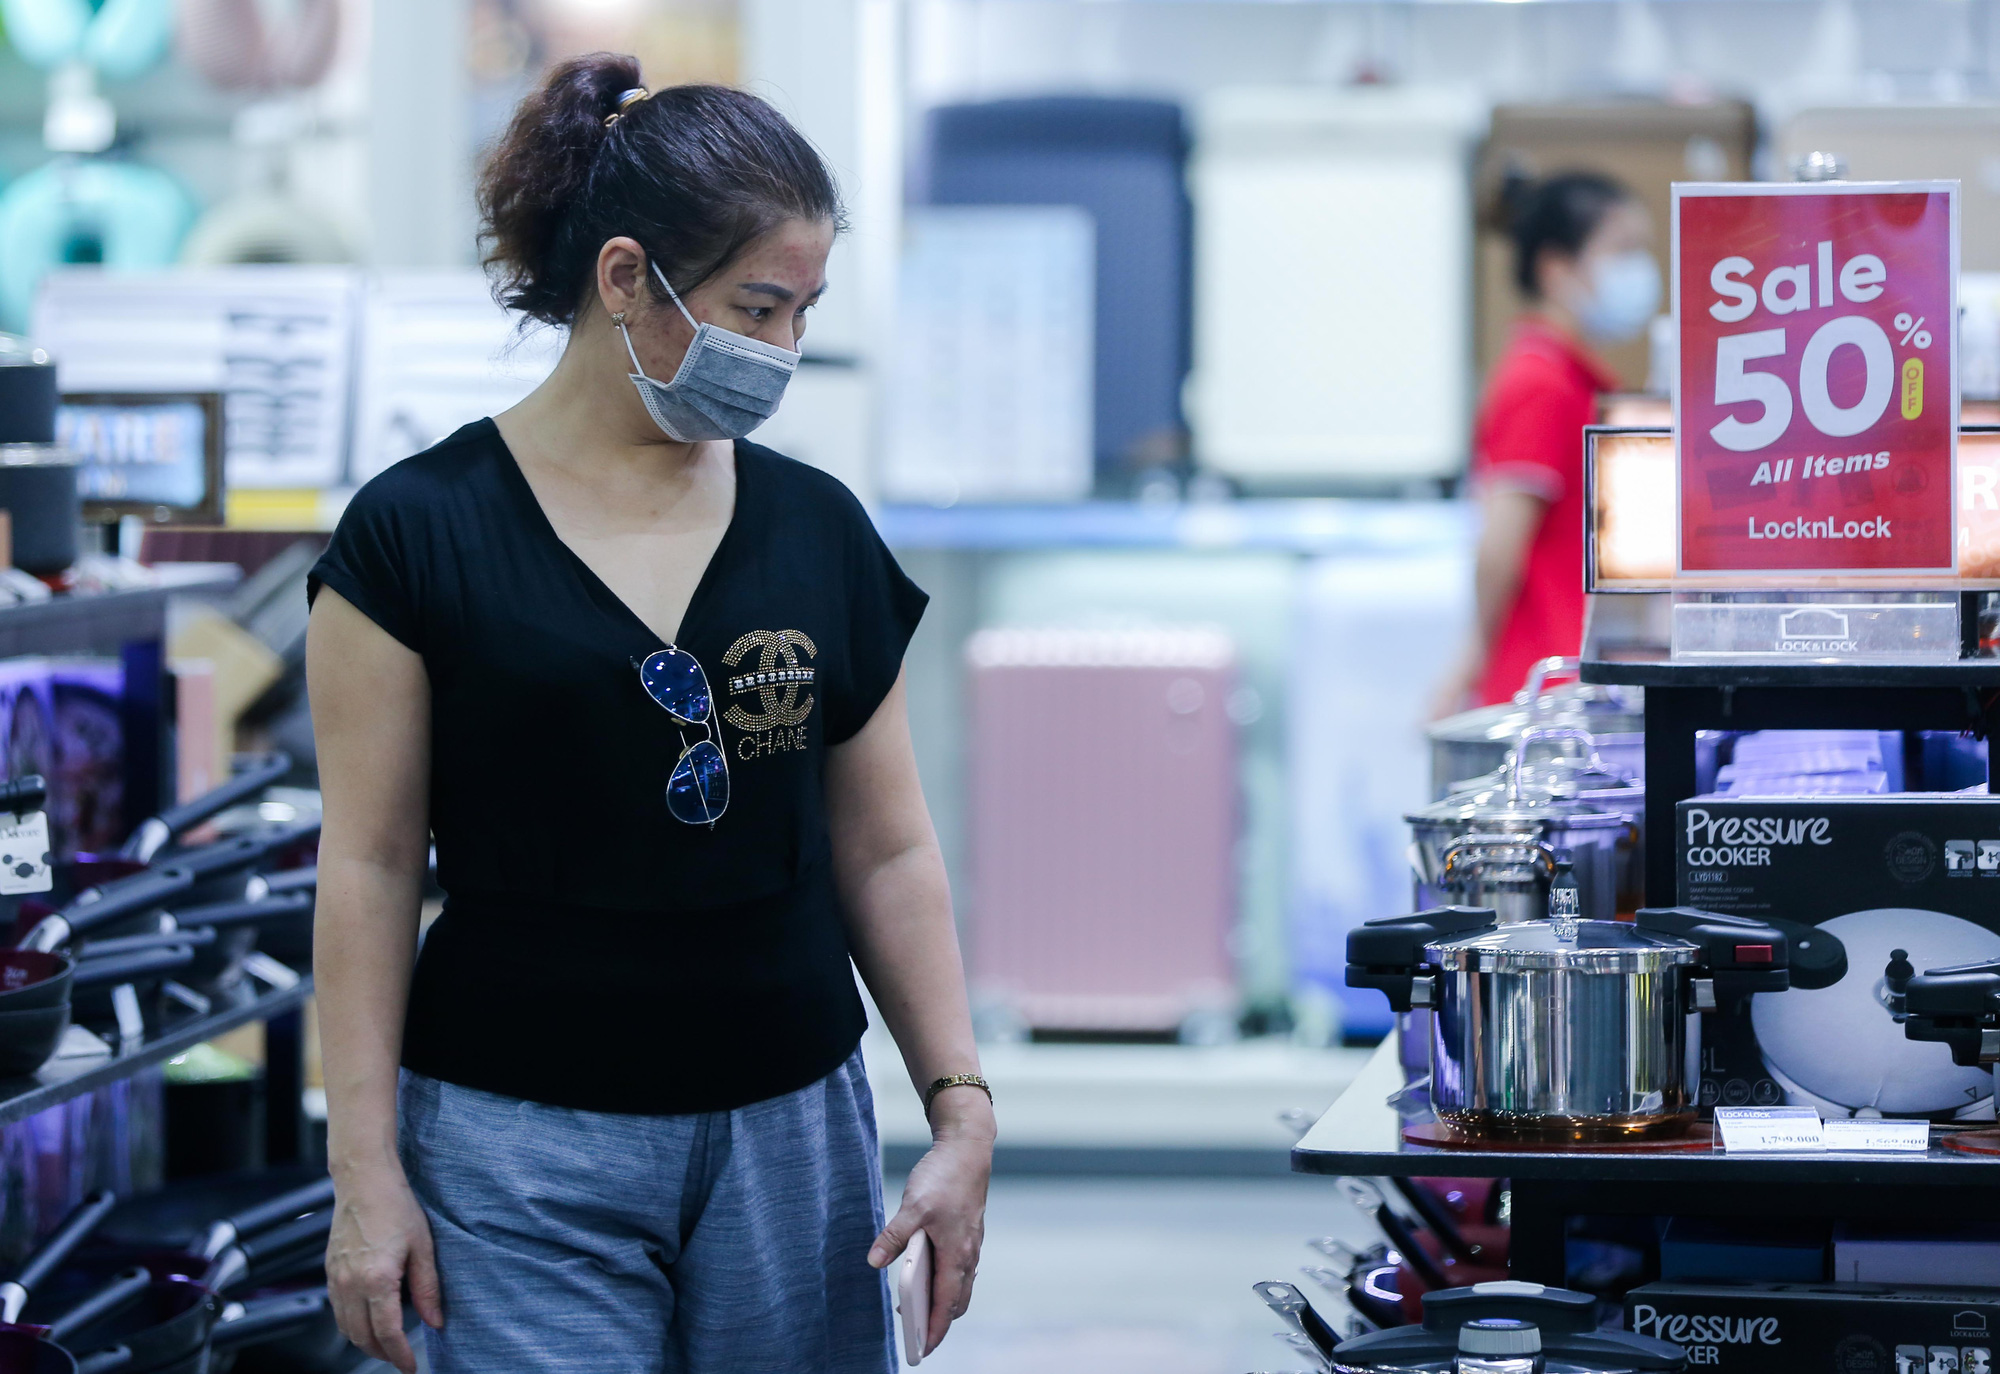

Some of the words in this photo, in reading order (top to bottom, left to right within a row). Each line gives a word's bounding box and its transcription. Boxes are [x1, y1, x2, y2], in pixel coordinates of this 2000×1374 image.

[1709, 240, 1887, 323] Sale
[1906, 367, 1920, 411] OFF
[1750, 458, 1793, 486] All
[1802, 450, 1890, 479] Items
[1748, 516, 1892, 540] LocknLock
[1686, 808, 1833, 846] Pressure
[1686, 847, 1771, 867] COOKER
[1634, 1304, 1781, 1345] Pressure
[1684, 1346, 1719, 1365] KER
